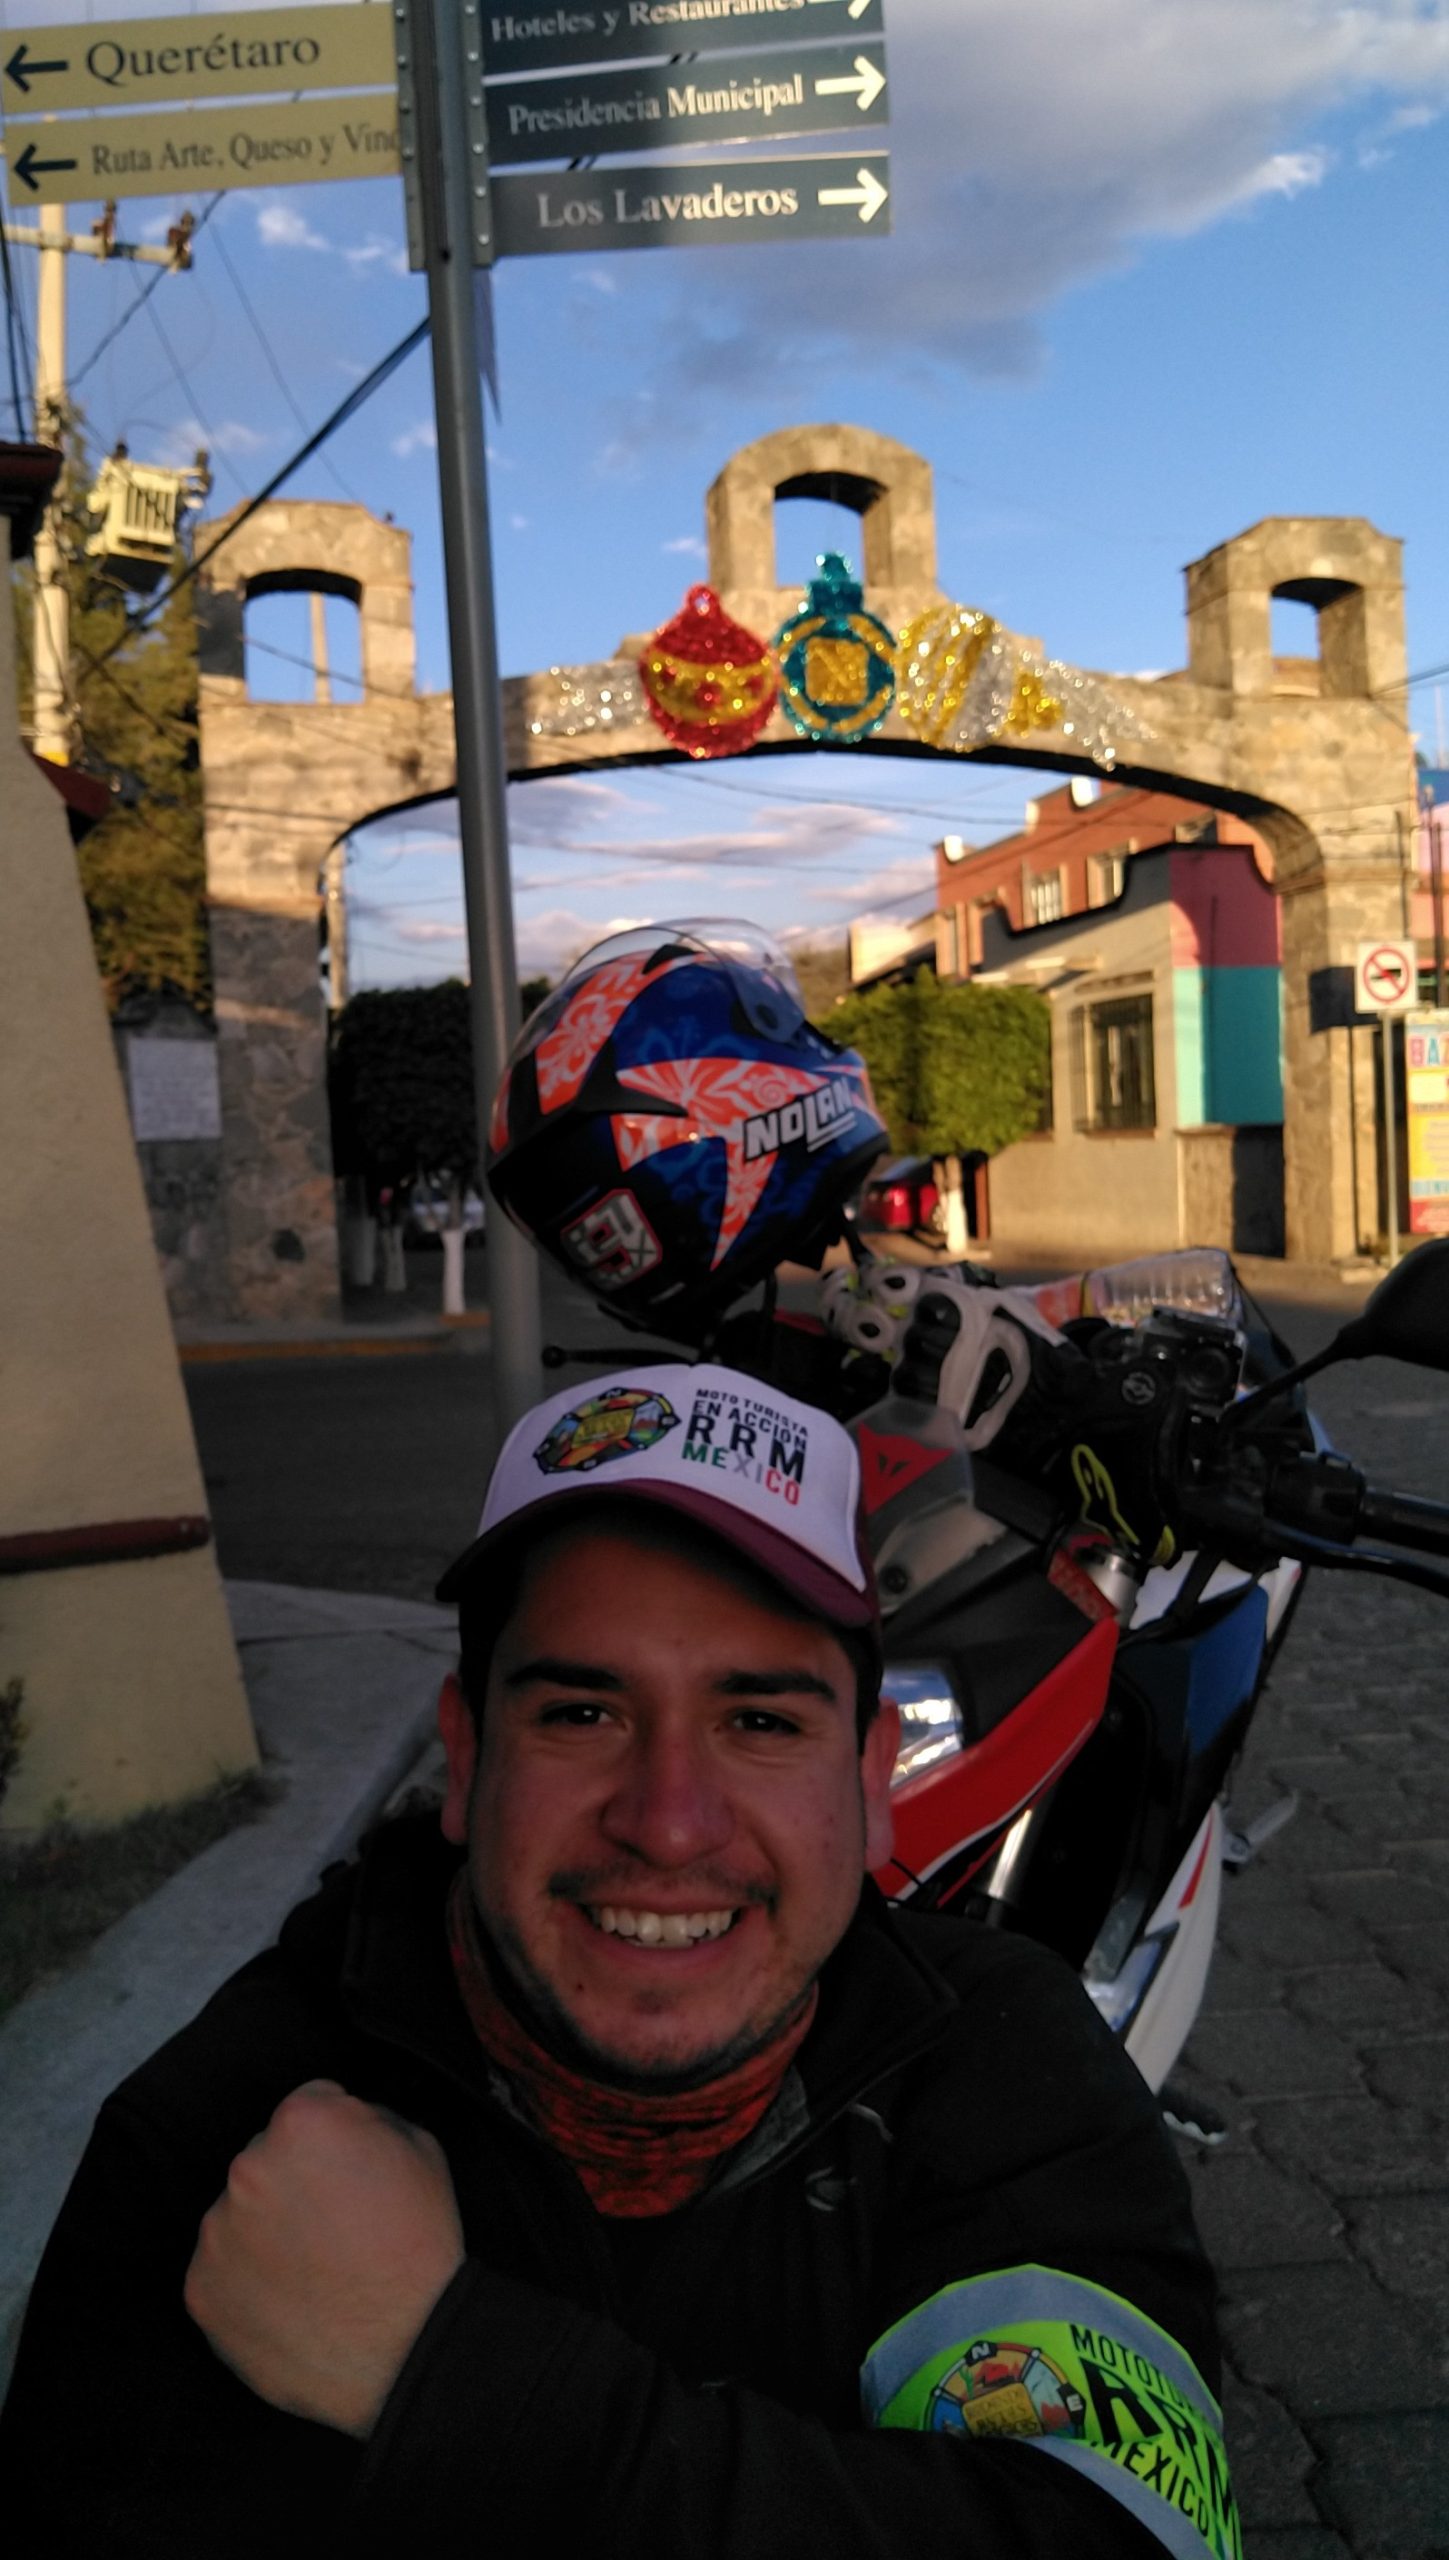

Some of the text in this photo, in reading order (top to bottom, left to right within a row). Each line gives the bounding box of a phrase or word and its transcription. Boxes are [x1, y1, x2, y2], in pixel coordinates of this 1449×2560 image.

[490, 9, 597, 41] Hoteles
[602, 10, 619, 36] y
[85, 34, 321, 88] Querétaro
[509, 74, 805, 136] Presidencia Municipal
[91, 145, 152, 176] Ruta
[160, 139, 224, 172] Arte,
[229, 132, 313, 171] Queso
[319, 134, 336, 166] y
[537, 182, 799, 228] Los Lavaderos
[744, 1076, 857, 1160] NOLAN
[692, 1399, 722, 1417] EN
[696, 1388, 739, 1404] MOTO
